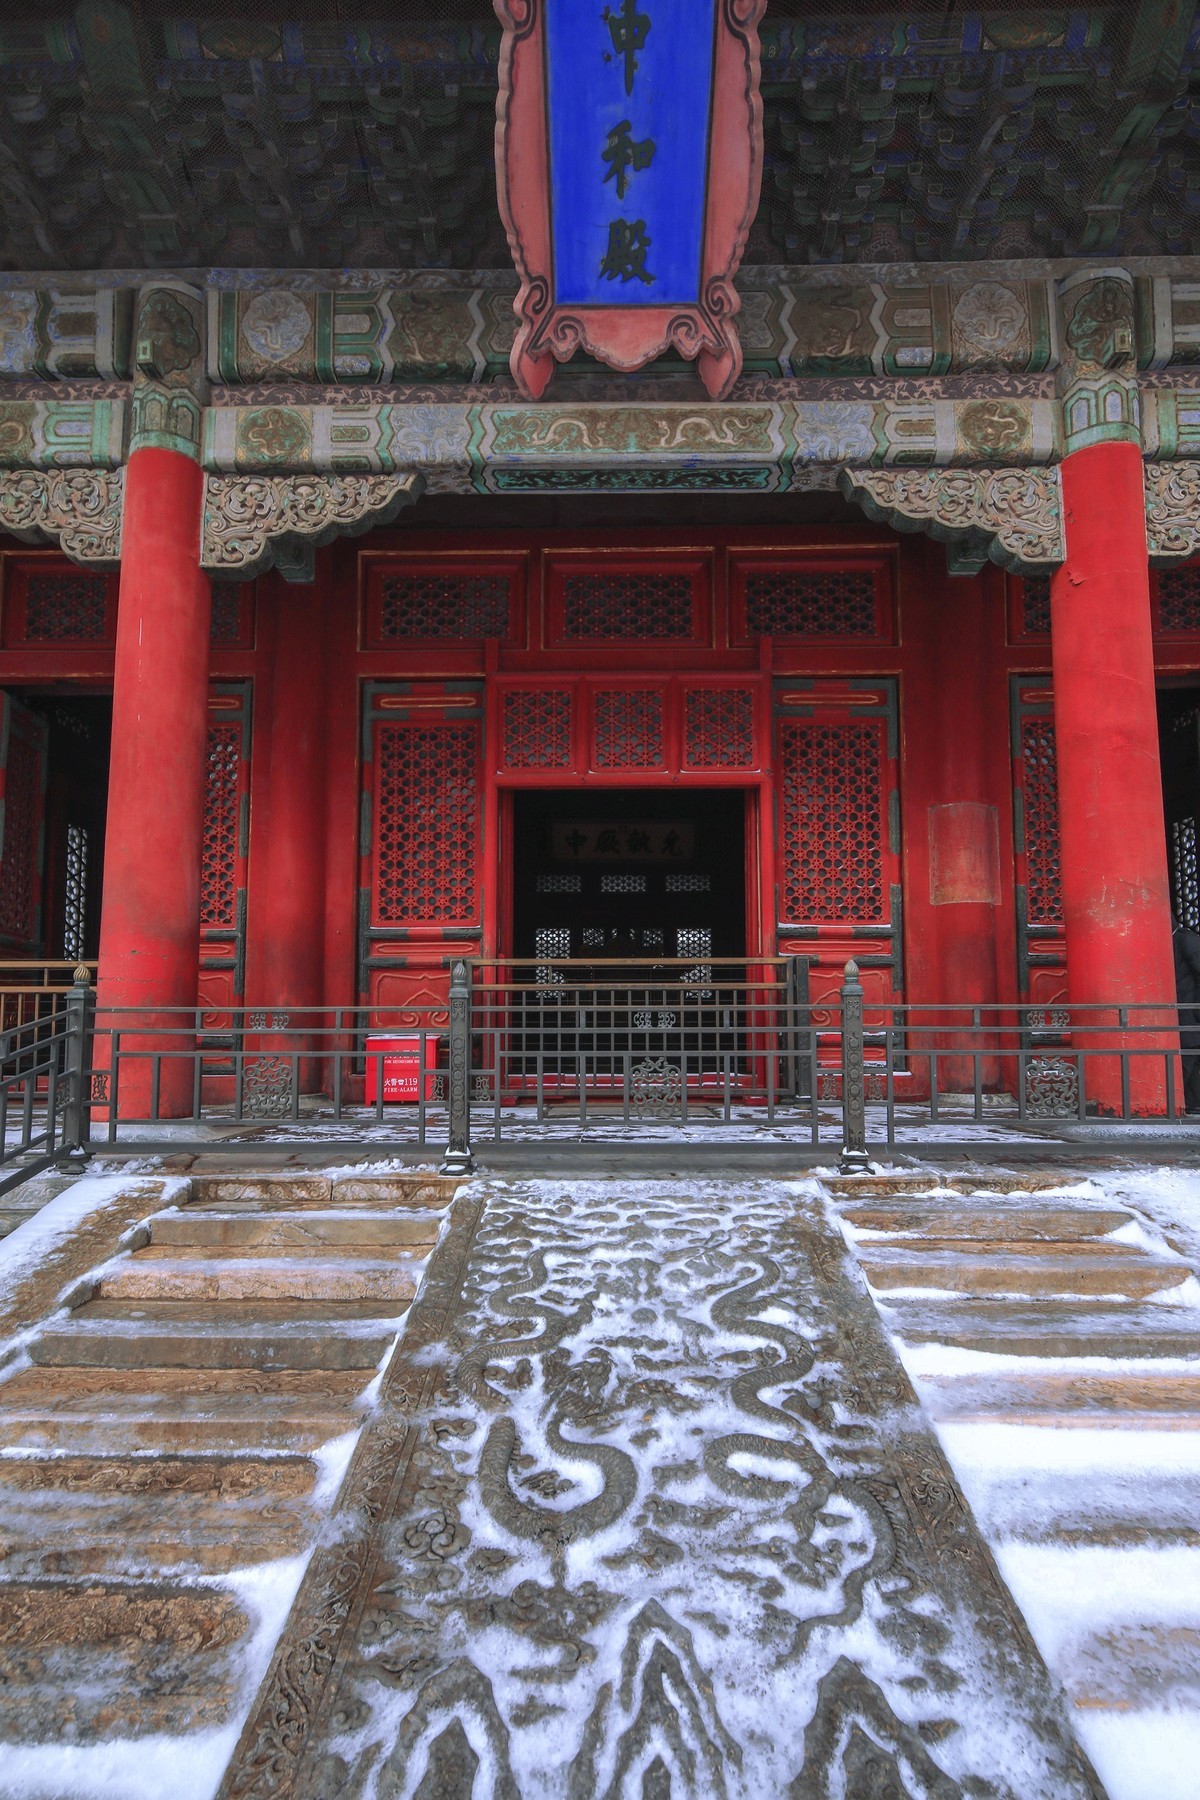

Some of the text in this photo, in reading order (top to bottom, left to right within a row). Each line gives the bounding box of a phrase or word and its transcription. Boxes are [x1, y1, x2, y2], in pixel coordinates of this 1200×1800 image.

[599, 0, 656, 284] 中和殿
[404, 1077, 418, 1086] 119
